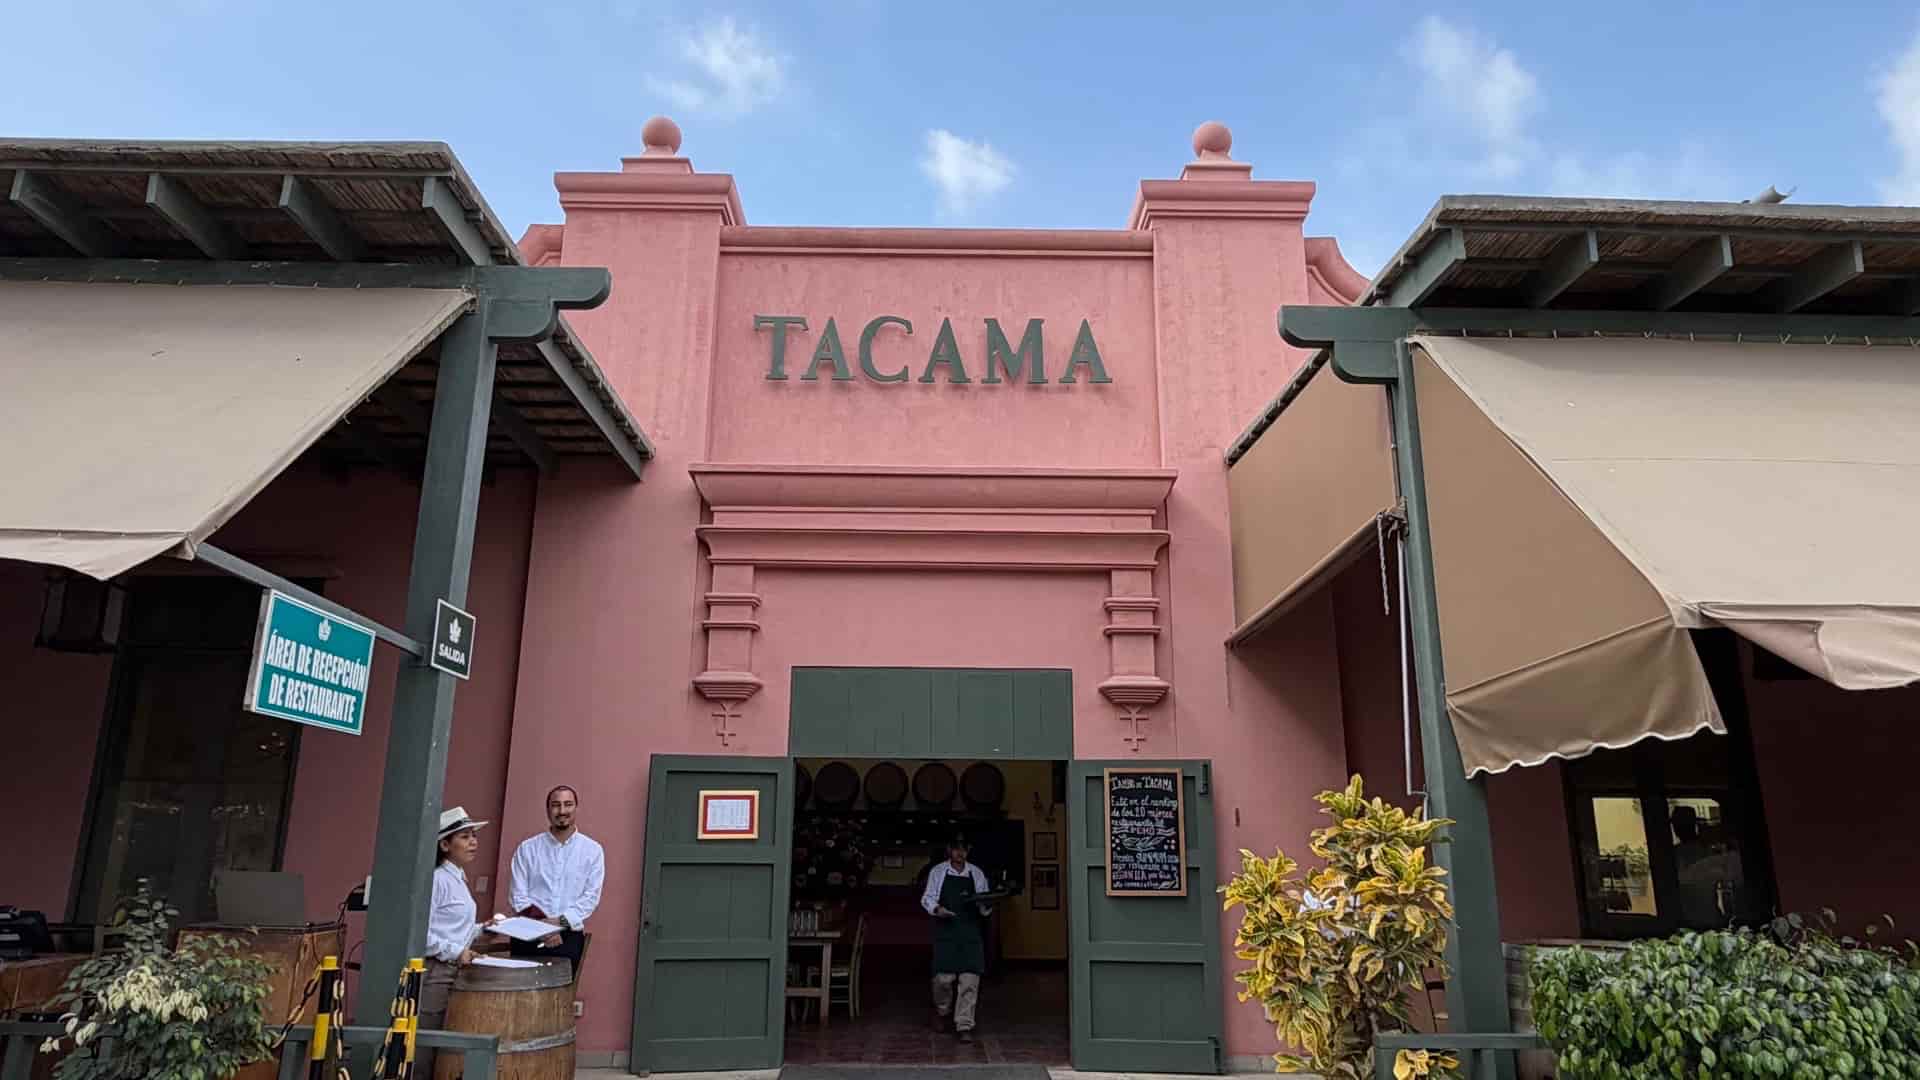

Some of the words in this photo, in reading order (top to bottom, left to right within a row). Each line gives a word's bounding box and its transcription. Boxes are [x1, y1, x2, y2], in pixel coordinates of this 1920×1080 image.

[753, 314, 1113, 384] TACAMA
[266, 628, 297, 671] ÁREA
[296, 643, 313, 676] DE
[311, 648, 368, 692] RECEPCIÓN
[438, 643, 466, 666] SALIDA
[268, 672, 287, 706] DE
[284, 678, 357, 723] RESTAURANTE
